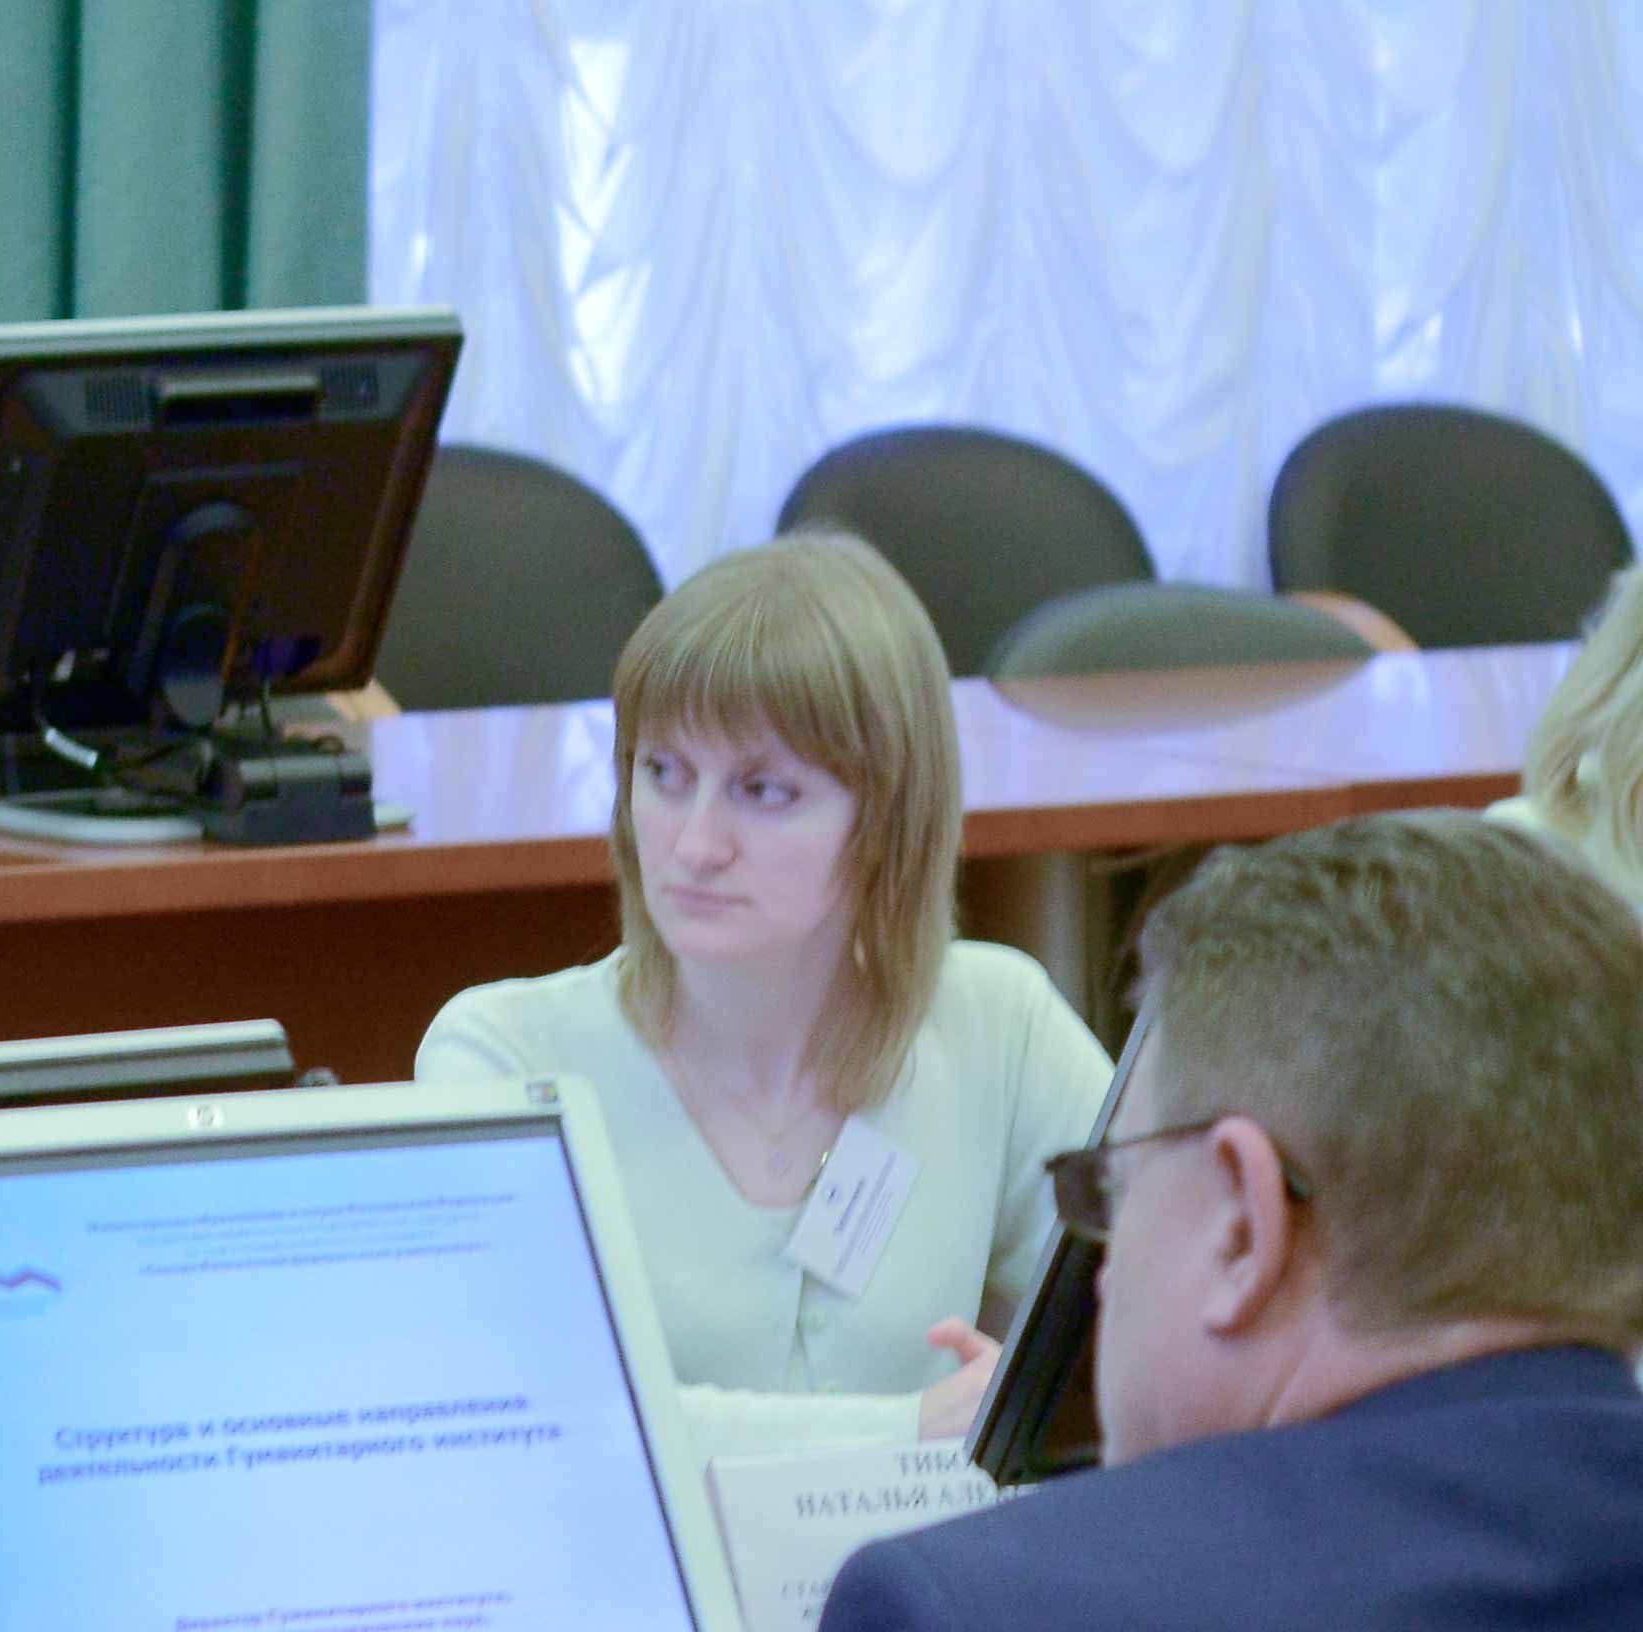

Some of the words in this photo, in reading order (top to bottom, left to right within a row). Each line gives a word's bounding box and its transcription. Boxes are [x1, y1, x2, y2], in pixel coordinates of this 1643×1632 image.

[54, 1420, 189, 1450] Структура
[199, 1417, 214, 1439] и
[222, 1409, 350, 1435] основные
[358, 1396, 528, 1425] направления
[38, 1452, 218, 1487] деятельности
[226, 1434, 424, 1470] Гуманитарного
[433, 1424, 563, 1450] института
